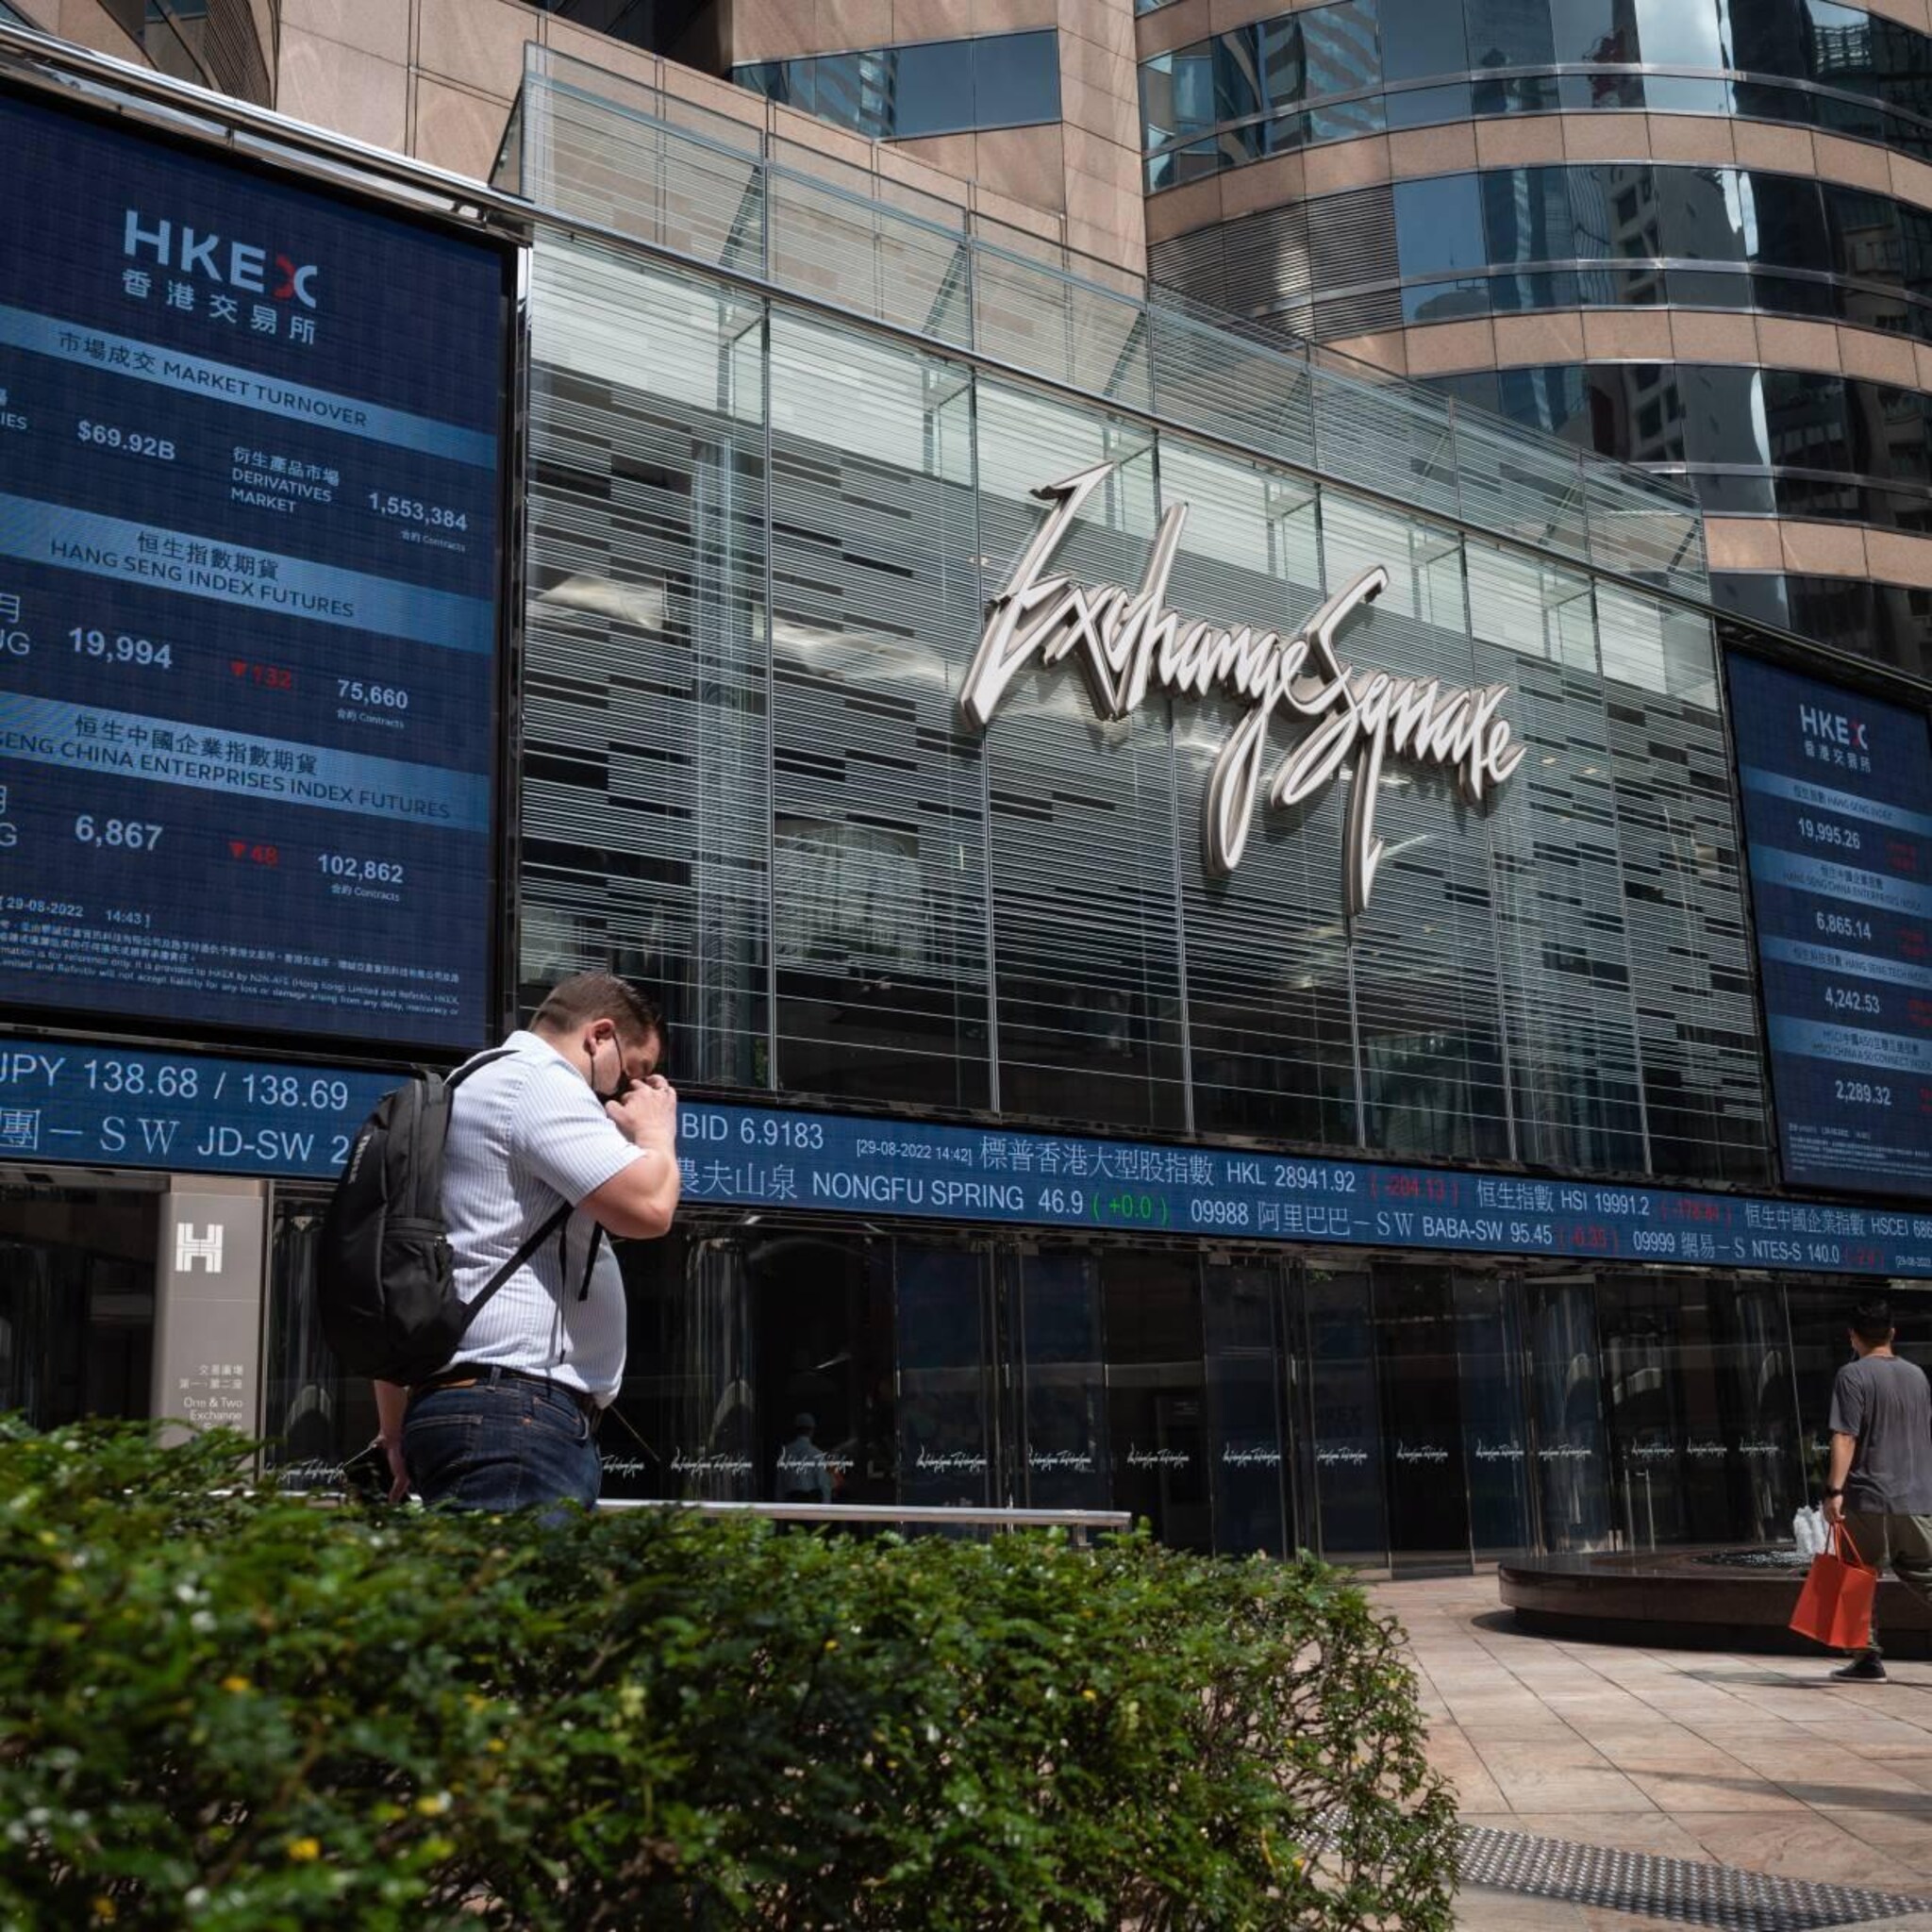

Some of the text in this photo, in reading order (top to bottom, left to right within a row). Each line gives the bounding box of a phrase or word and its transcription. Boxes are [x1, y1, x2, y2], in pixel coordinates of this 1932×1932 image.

[124, 209, 318, 308] HKEX
[122, 268, 316, 345] 香港交易所
[58, 331, 367, 427] 市場成交 MARKET TURNOVER
[77, 419, 176, 460] $69.92B
[230, 488, 296, 513] MARKET
[231, 468, 332, 502] DERIVATIVES
[369, 492, 468, 531] 1,553,384
[50, 539, 355, 618] HANG SENG INDEX FUTURES
[137, 530, 279, 582] 恒生指數期貨
[69, 627, 173, 670] 19,994
[337, 679, 409, 711] 75,660
[358, 711, 405, 730] Contracts
[1800, 704, 1869, 751] HKEX
[75, 714, 317, 775] 恒生中國企業指數期貨
[60, 740, 133, 769] CHINA
[141, 755, 287, 793] ENTERPRISES
[291, 778, 353, 806] INDEX
[358, 791, 450, 820] FUTURES
[75, 814, 163, 852] 6,867
[318, 854, 404, 885] 102,862
[1798, 817, 1860, 850] 19,995.26
[354, 886, 400, 903] Contracts
[1816, 911, 1872, 941] 6,865.14
[1825, 987, 1880, 1014] 4,242.53
[84, 1058, 199, 1099] 138.68
[242, 1074, 349, 1110] 138.69
[1835, 1080, 1891, 1106] 2,289.32
[197, 1125, 315, 1162] JD-SW
[682, 1112, 728, 1141] BID
[740, 1118, 824, 1150] 6.9183
[980, 1136, 1214, 1187] 標普香港大型股指數
[1226, 1160, 1268, 1186] HKL
[1275, 1163, 1357, 1192] 28941.92
[1477, 1178, 1554, 1212] 恒生指數
[1561, 1191, 1588, 1211] HSI
[1595, 1192, 1650, 1216] 19991.2
[1745, 1203, 1866, 1237] 恒生中國企業指數
[1871, 1217, 1908, 1236] HSCEI
[813, 1172, 923, 1205] NONGFU
[931, 1181, 1024, 1210] SPRING
[1038, 1188, 1083, 1214] 46.9
[1191, 1199, 1249, 1225] 09988
[1423, 1216, 1502, 1241] BABA-SW
[1510, 1223, 1553, 1244] 95.45
[1633, 1231, 1674, 1252] 09999
[1752, 1240, 1801, 1261] NTES-S
[1807, 1243, 1840, 1264] 140.0
[220, 1396, 242, 1408] Two
